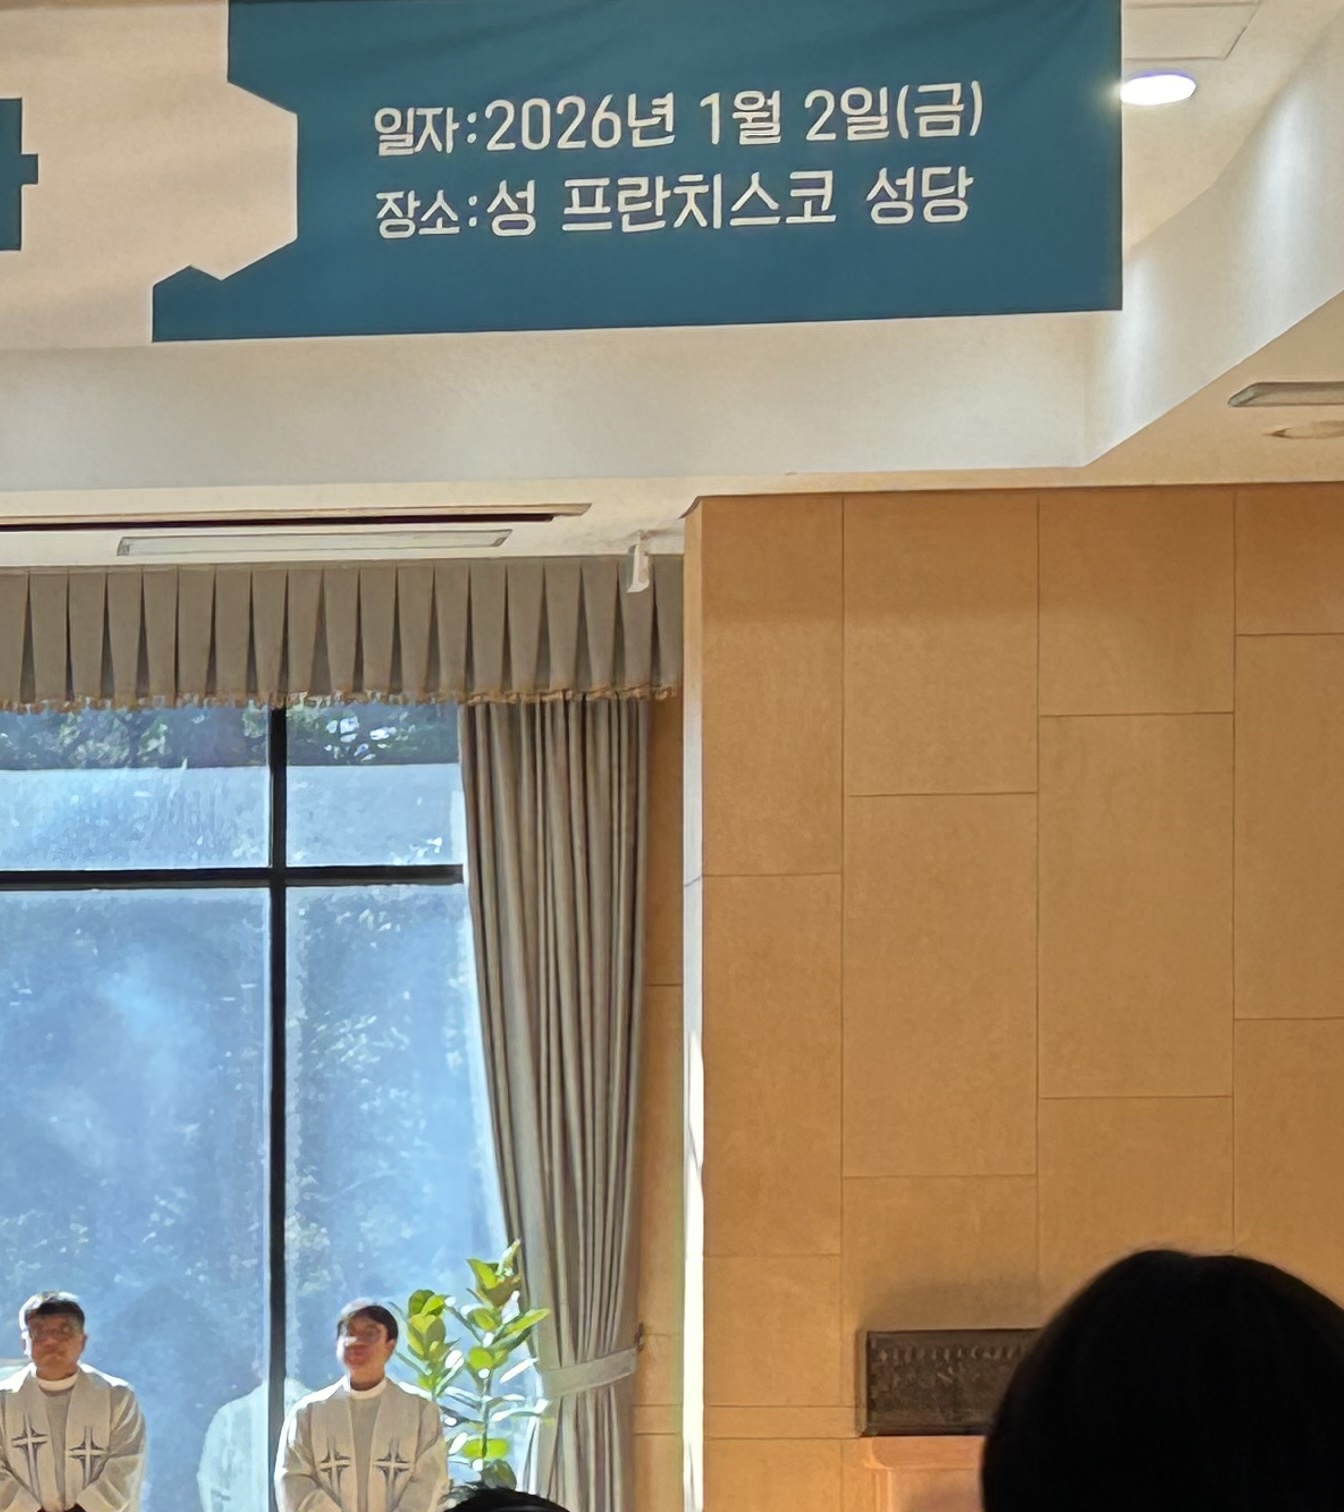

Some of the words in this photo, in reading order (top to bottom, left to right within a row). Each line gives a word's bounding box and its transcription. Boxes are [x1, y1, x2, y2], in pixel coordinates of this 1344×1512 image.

[373, 92, 677, 157] 일자:2026년
[699, 90, 782, 146] 1월
[804, 80, 984, 142] 2일(금)
[561, 170, 838, 234] 프란치스코
[866, 165, 975, 226] 성당
